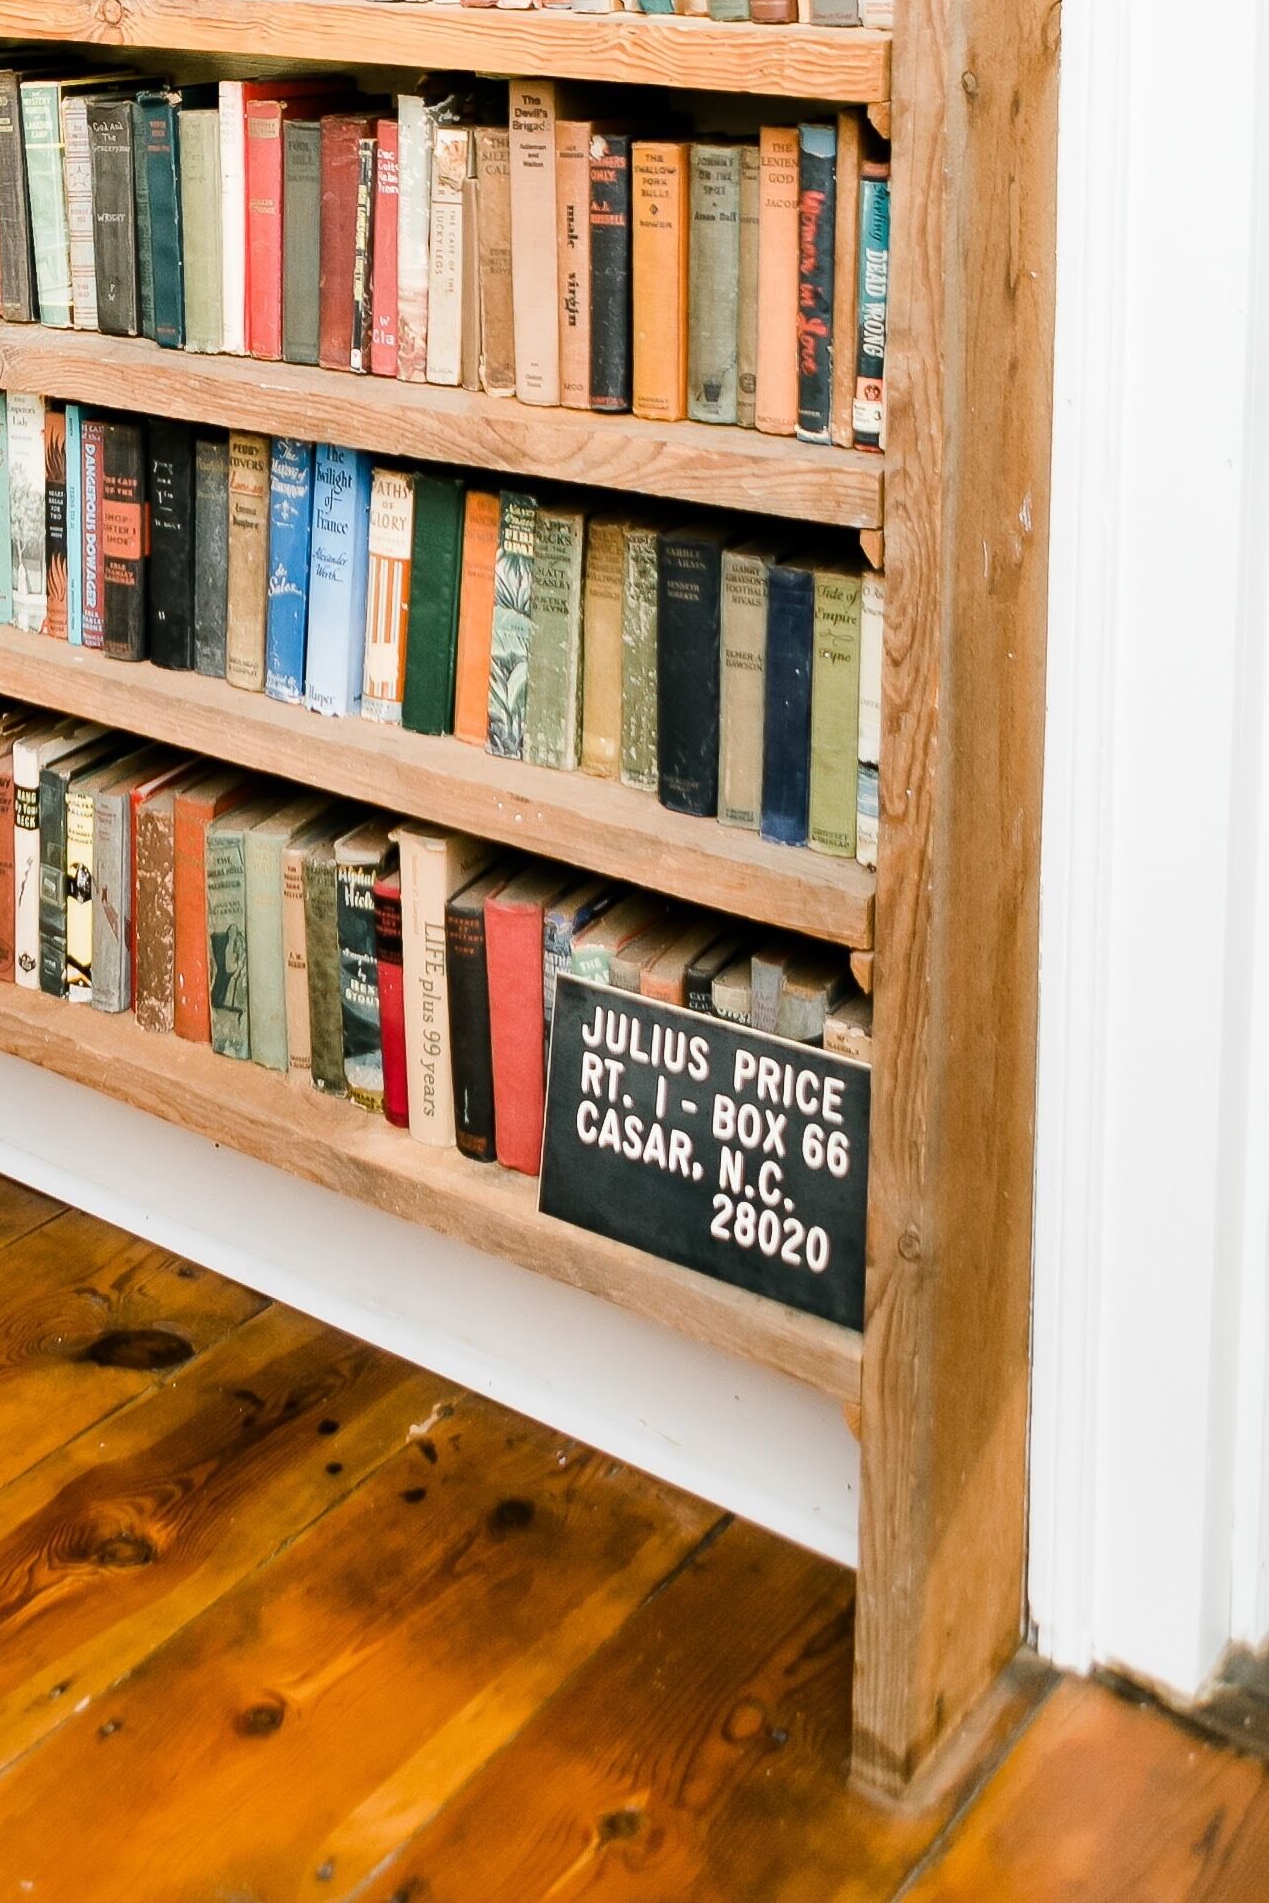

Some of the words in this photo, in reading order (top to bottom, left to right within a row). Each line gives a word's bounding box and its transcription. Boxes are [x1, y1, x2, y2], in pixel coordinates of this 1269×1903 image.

[515, 108, 548, 119] Devil's
[522, 95, 541, 105] The
[644, 154, 664, 164] THE
[591, 171, 616, 181] ONLY
[642, 178, 667, 186] FORK
[768, 172, 794, 184] GOD
[97, 213, 126, 222] WRIGHT
[436, 210, 444, 244] LUCKY
[566, 205, 579, 249] male
[865, 248, 887, 297] DEAD
[563, 272, 579, 327] virgin
[278, 442, 298, 460] The
[325, 445, 345, 464] The
[84, 443, 96, 532] DANGEROUS
[316, 462, 353, 489] Twilight
[325, 489, 342, 514] of
[316, 515, 349, 536] France
[312, 548, 348, 566] Alexander
[85, 534, 97, 608] DOWAGER
[308, 683, 333, 706] Harper
[424, 921, 446, 977] LIFE
[418, 976, 435, 1024] plus
[423, 1030, 441, 1056] 99
[582, 1006, 710, 1081] JULIUS
[422, 1058, 435, 1117] years
[734, 1049, 845, 1125] PRICE
[581, 1051, 634, 1109] RT.
[681, 1100, 698, 1114] -
[712, 1093, 788, 1157] BOX
[802, 1123, 851, 1178] 66
[719, 1146, 795, 1210] N.C.
[710, 1193, 830, 1274] 28020
